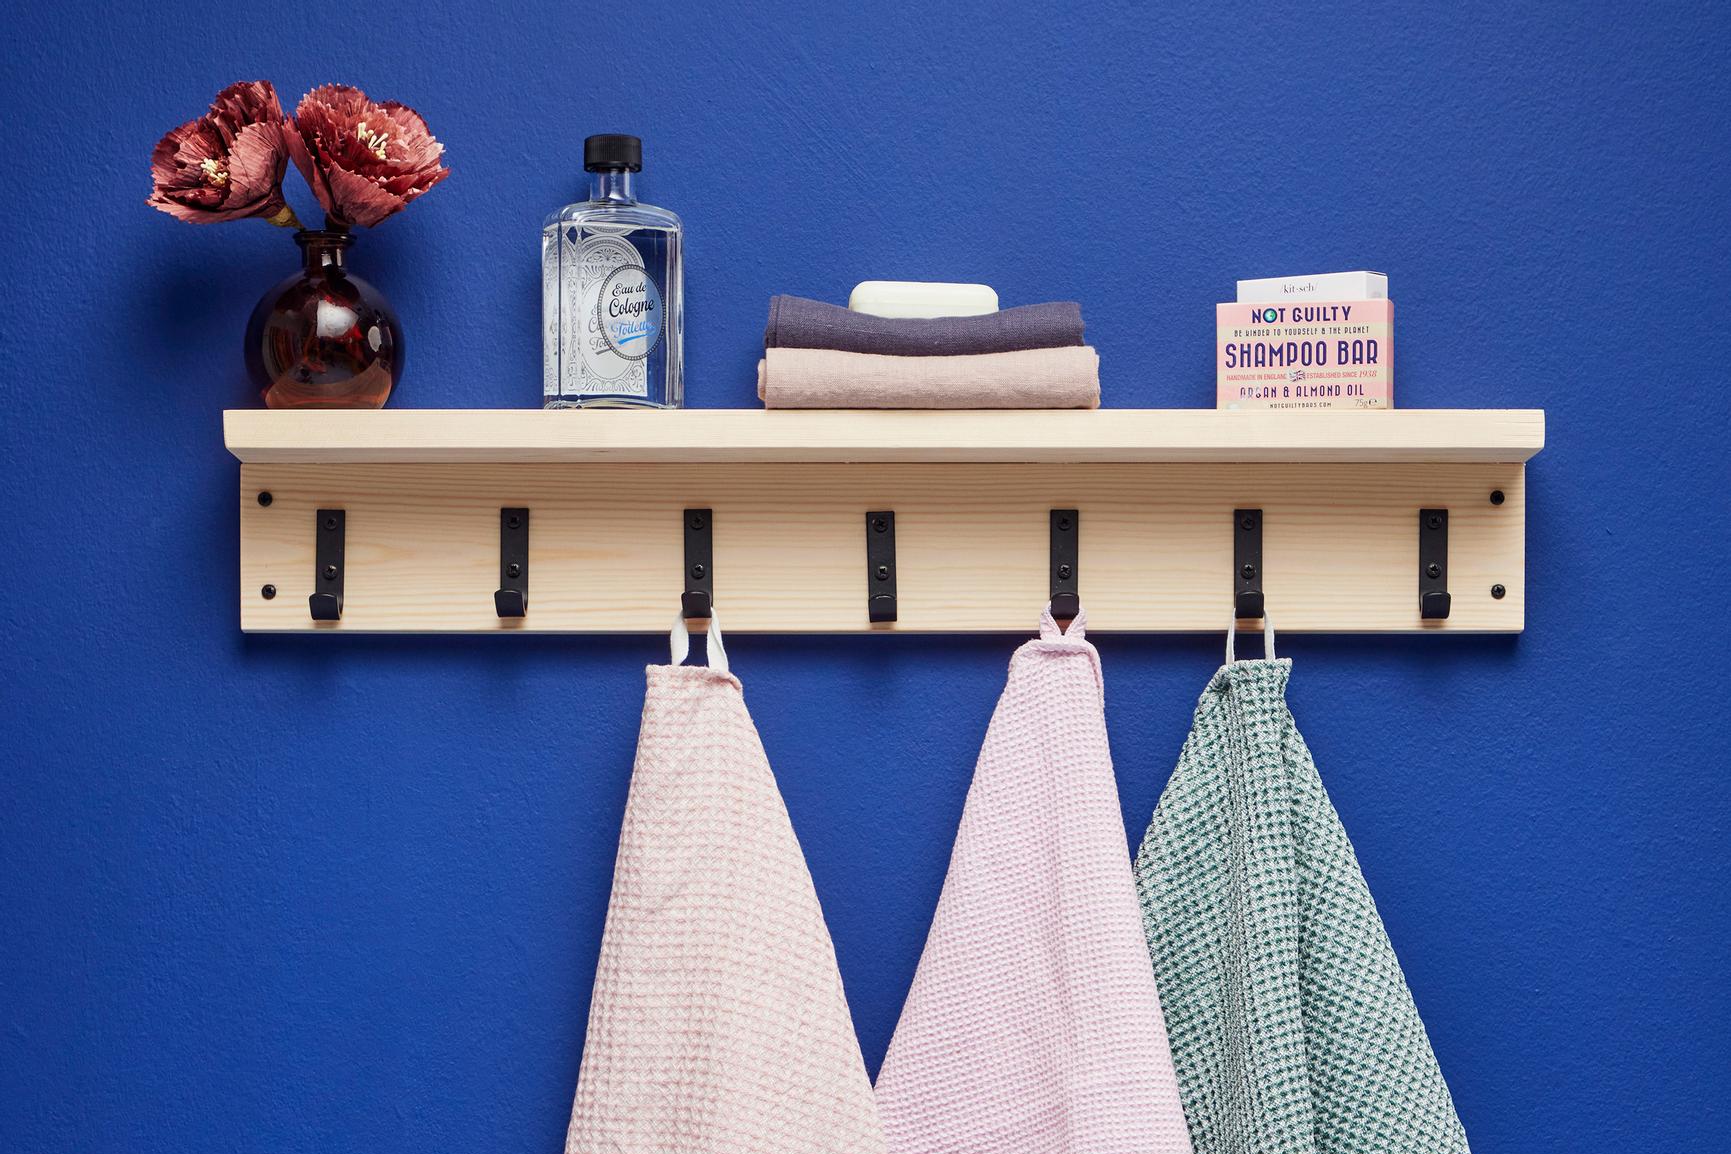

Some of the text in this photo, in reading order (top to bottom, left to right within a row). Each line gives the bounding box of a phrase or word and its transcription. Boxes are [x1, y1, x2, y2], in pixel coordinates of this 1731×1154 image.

[612, 282, 646, 297] Eau de
[609, 298, 654, 317] Cologne
[1252, 306, 1351, 324] NOT GUILTY
[1234, 329, 1242, 337] BE
[1245, 329, 1270, 337] KINDER
[1273, 328, 1281, 336] TO
[1284, 327, 1317, 336] YOURSELF
[1329, 326, 1341, 335] THE
[1344, 325, 1370, 334] PLANET
[1225, 339, 1378, 369] SHAMPOO BAR
[1306, 371, 1341, 380] ESTABLISHED
[1359, 370, 1377, 378] 1938
[1240, 384, 1364, 399] ARGAN & ALMOND OIL
